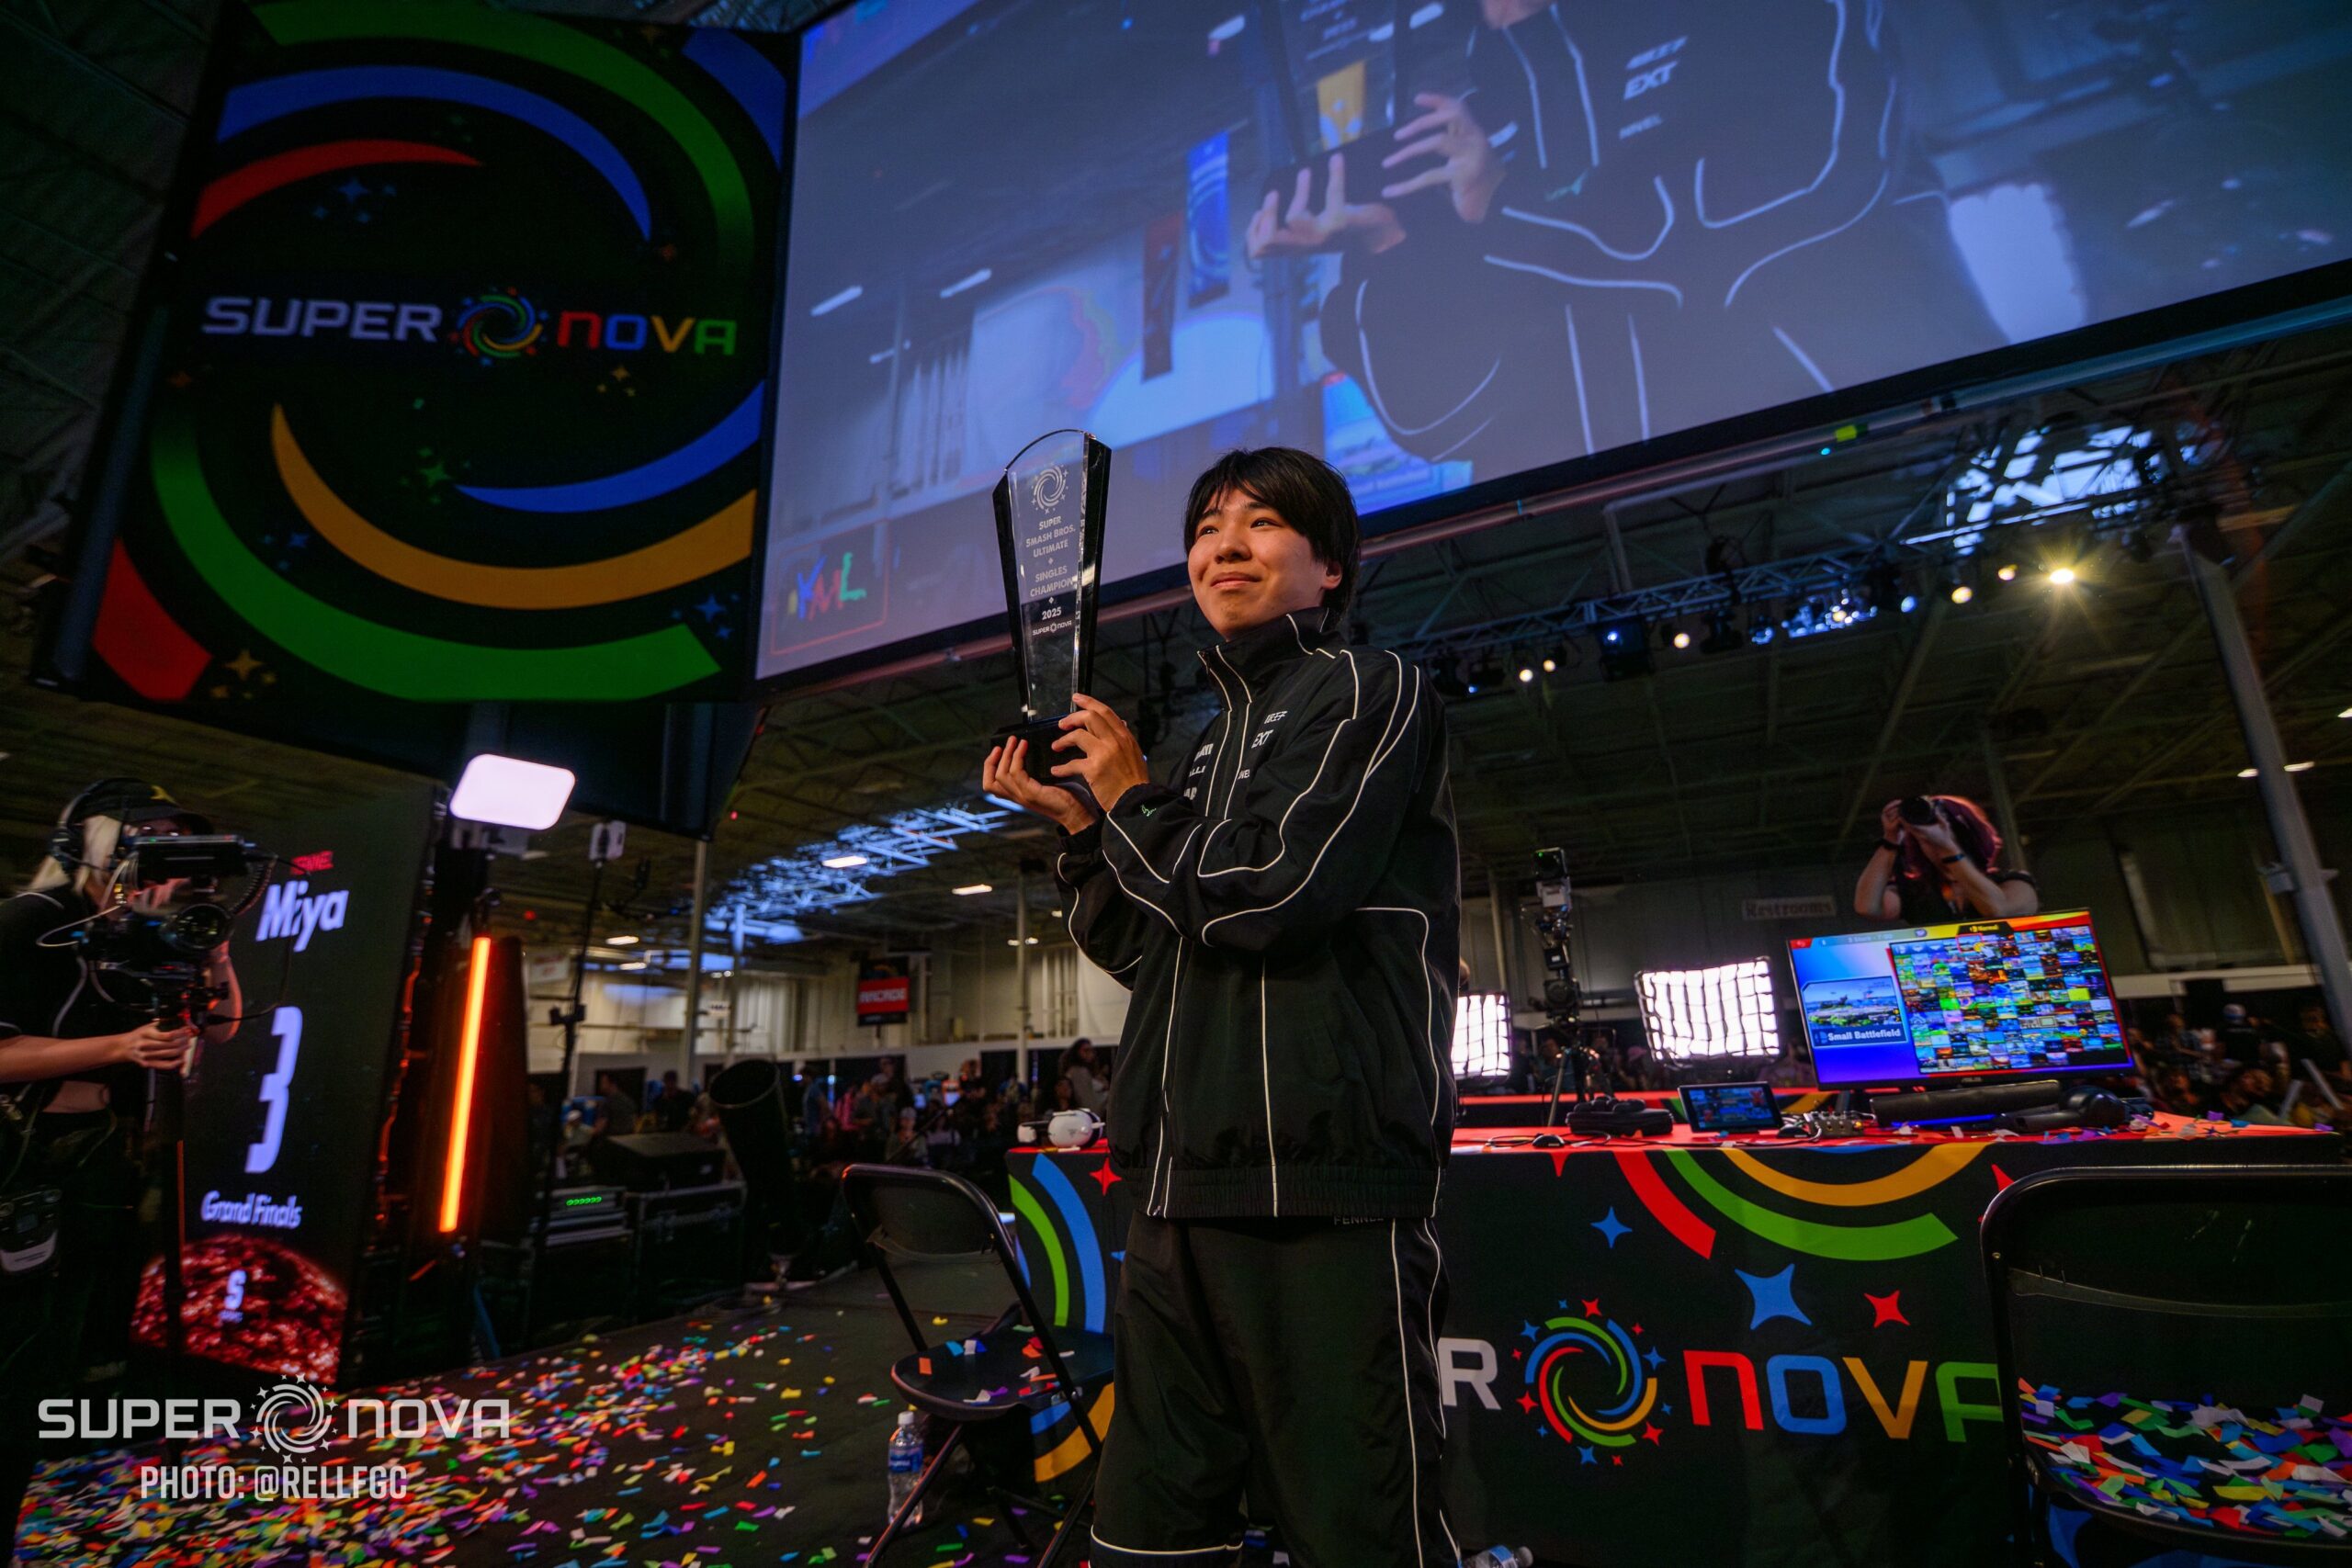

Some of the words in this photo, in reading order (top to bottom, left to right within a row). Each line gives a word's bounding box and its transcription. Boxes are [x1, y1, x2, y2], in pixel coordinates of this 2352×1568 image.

[201, 295, 444, 344] SUPER
[557, 310, 738, 355] NOVA
[1039, 516, 1062, 530] SUPER
[1025, 532, 1053, 547] SMASH
[1054, 525, 1076, 537] BROS.
[1033, 539, 1069, 558] ULTIMATE
[1035, 565, 1068, 583] SINGLES
[1030, 579, 1074, 597] CHAMPION
[1041, 606, 1062, 621] 2025
[1032, 626, 1050, 636] SUPER
[1057, 620, 1072, 629] NOVA
[1251, 729, 1274, 748] EXT
[256, 880, 350, 953] Miya
[1827, 1032, 1853, 1042] Small
[1854, 1028, 1901, 1040] Battlefield
[243, 1006, 304, 1175] 3
[200, 1190, 255, 1224] Grand
[251, 1193, 303, 1230] Finals
[1683, 1349, 2004, 1443] NOVA
